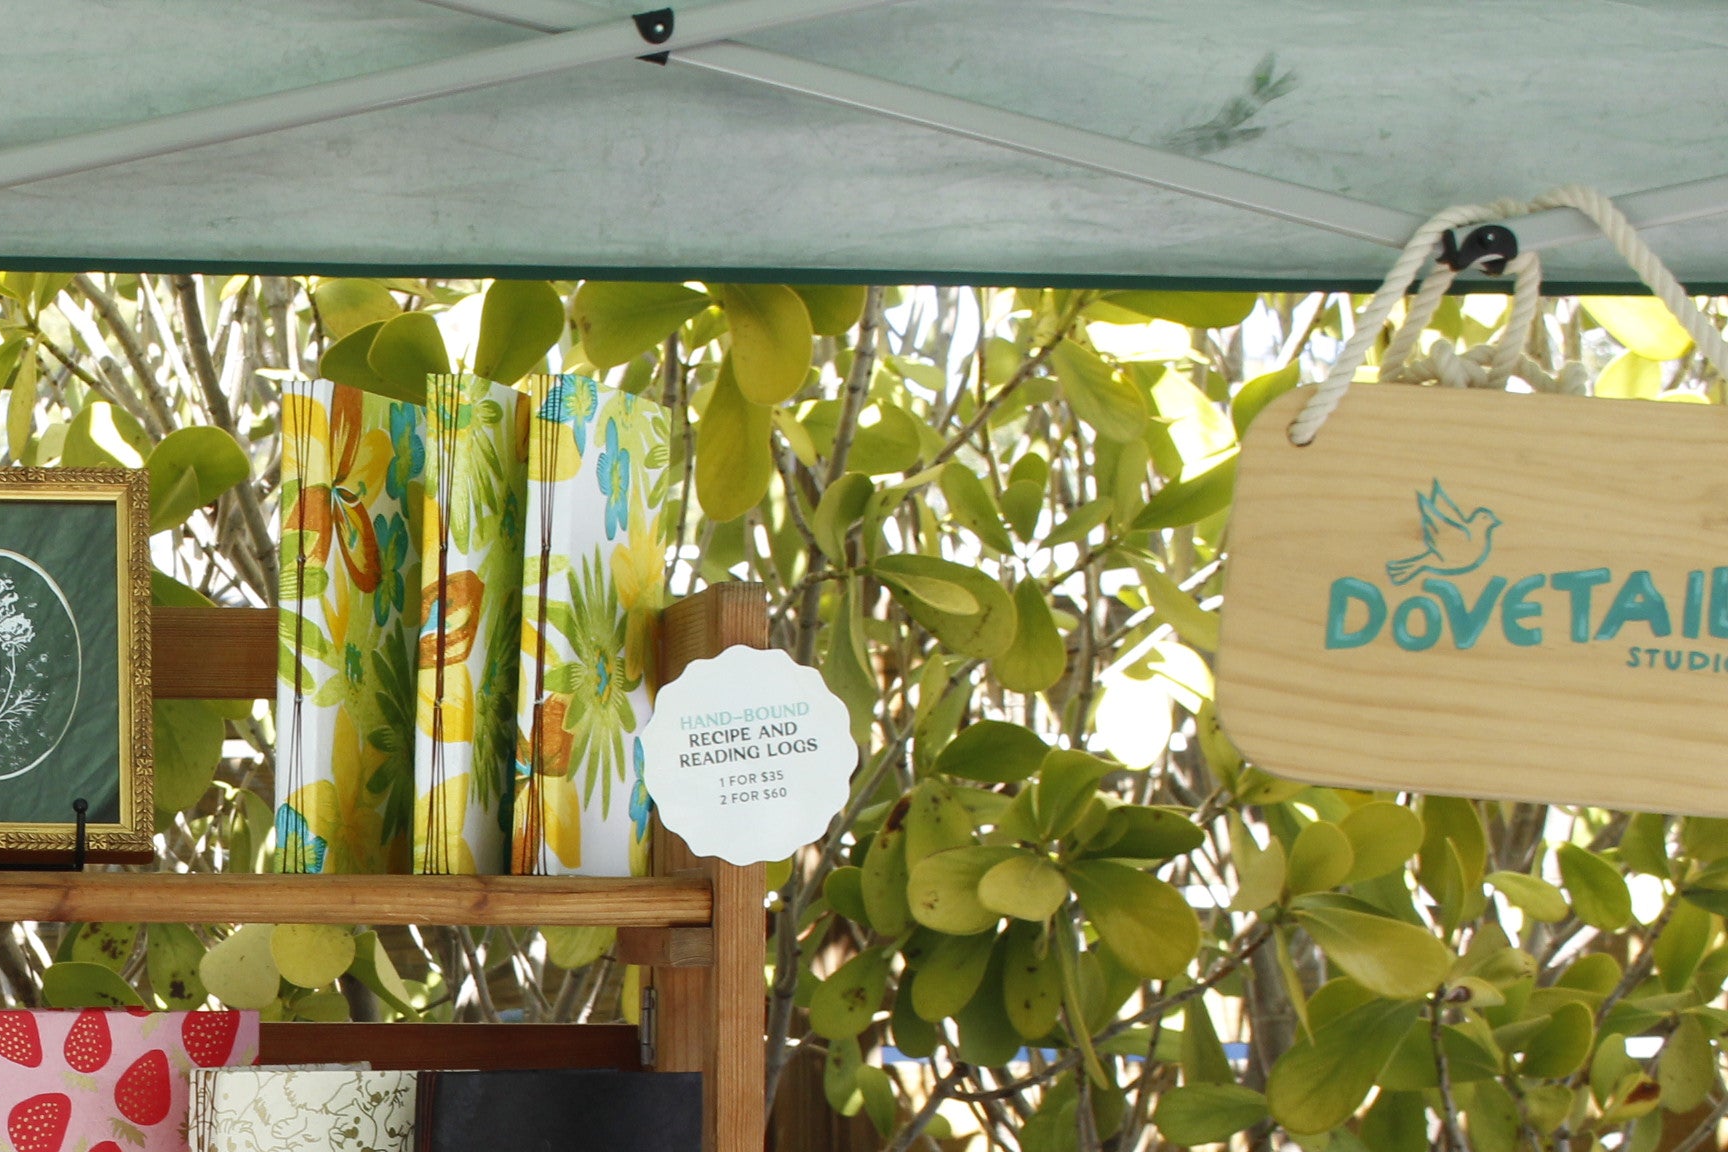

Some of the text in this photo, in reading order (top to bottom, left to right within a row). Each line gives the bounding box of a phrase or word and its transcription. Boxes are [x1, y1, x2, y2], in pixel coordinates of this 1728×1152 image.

[1626, 646, 1728, 673] STUDI
[680, 701, 810, 730] HAND-BOUND
[689, 721, 798, 748] RECIPE AND
[679, 738, 819, 768] READING LOGS
[719, 770, 784, 787] 1 FOR $35
[720, 787, 787, 805] 2 FOR $60
